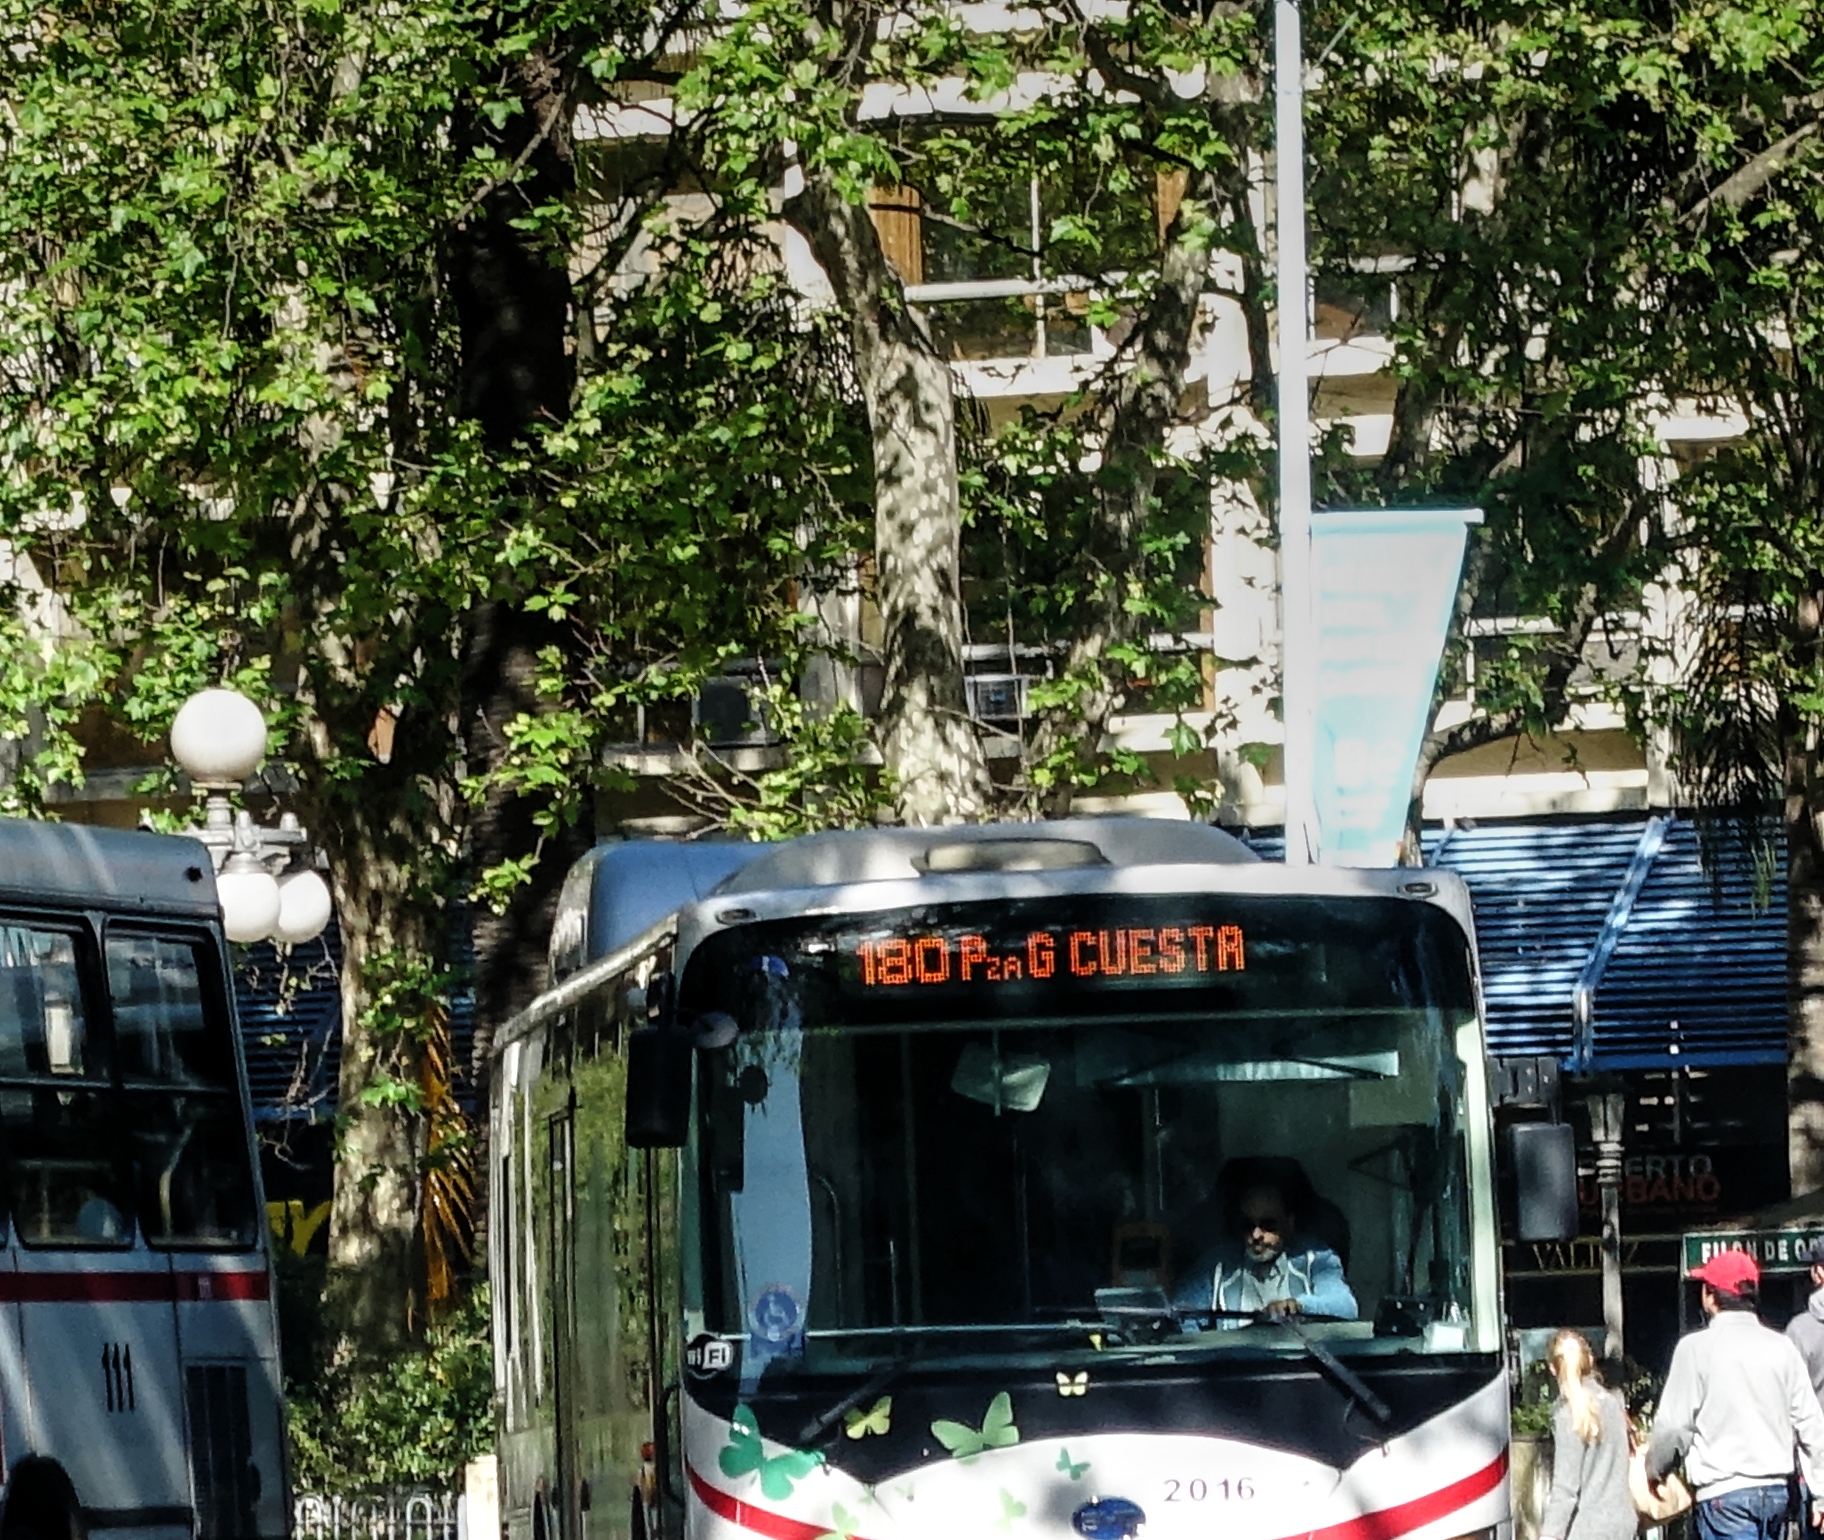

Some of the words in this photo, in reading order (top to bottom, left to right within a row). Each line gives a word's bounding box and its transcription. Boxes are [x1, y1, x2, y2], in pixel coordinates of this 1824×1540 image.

[856, 936, 950, 986] 180
[1027, 931, 1056, 979] G
[1069, 925, 1246, 977] CUESTA
[1578, 1174, 1721, 1205] UBANO
[1764, 1239, 1789, 1262] DE
[102, 1342, 135, 1413] 111
[1163, 1476, 1256, 1502] 2016
